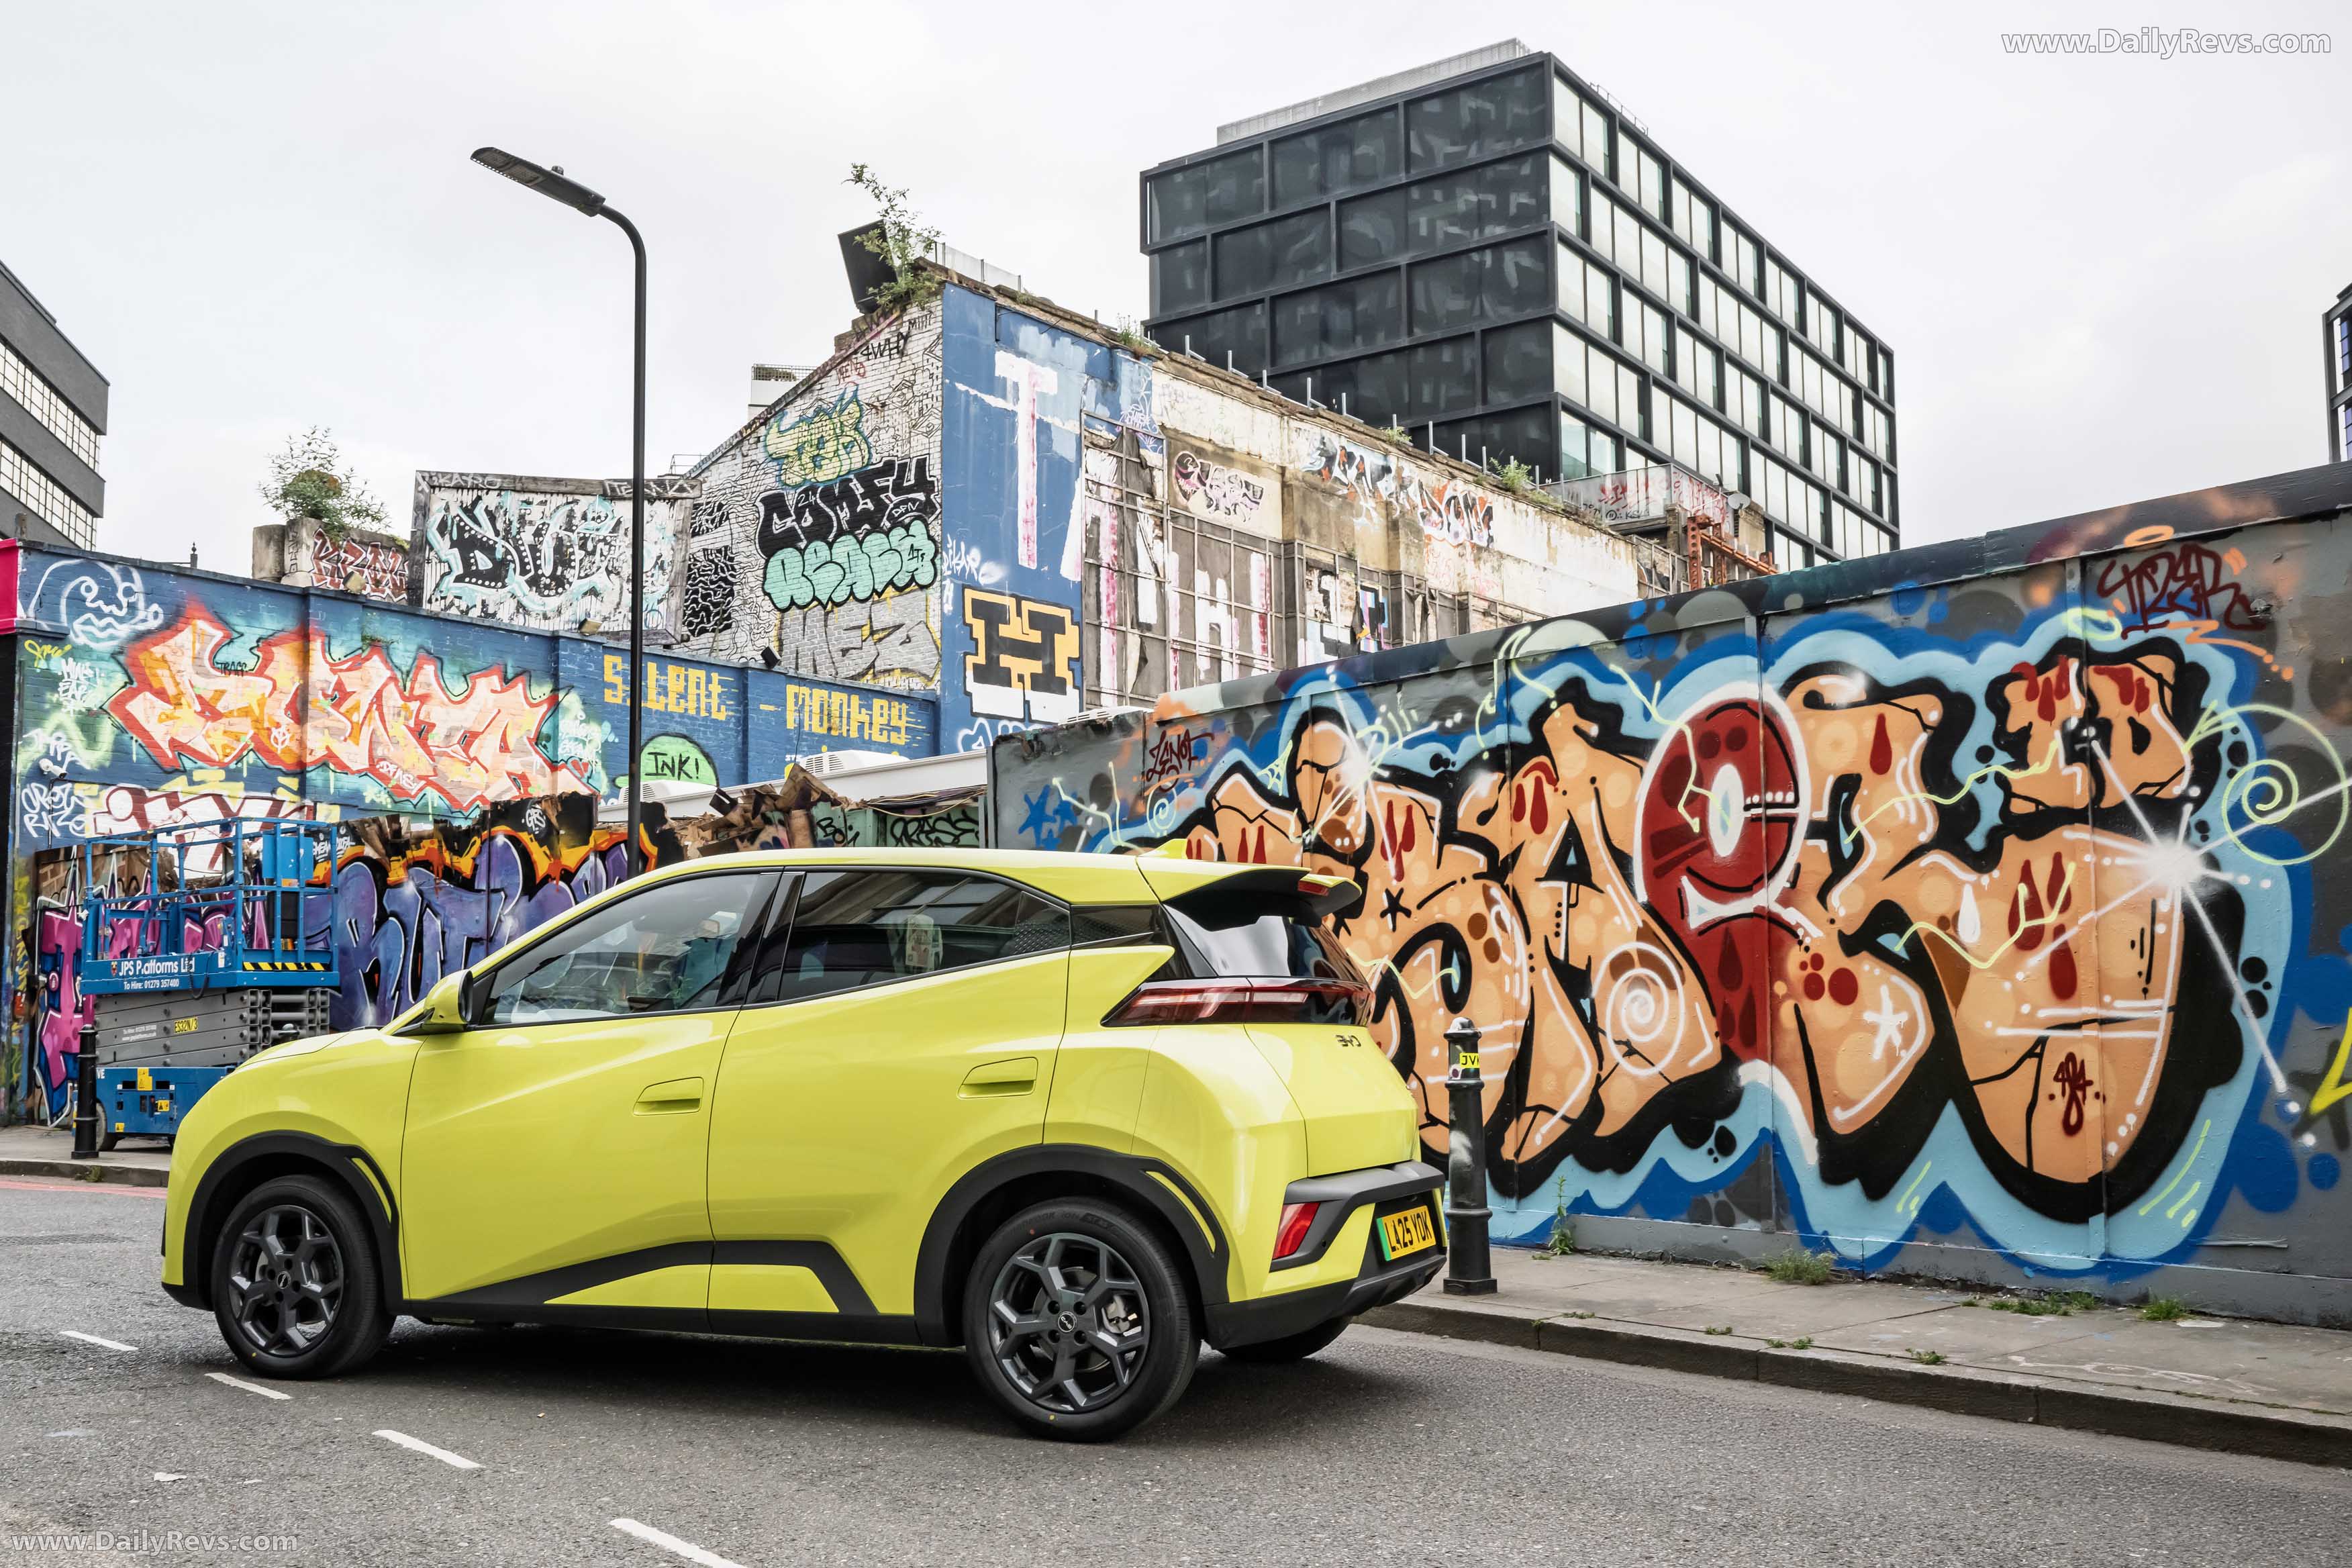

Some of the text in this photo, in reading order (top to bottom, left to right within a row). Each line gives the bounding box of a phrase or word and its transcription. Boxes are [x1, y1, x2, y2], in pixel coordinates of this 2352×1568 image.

[645, 752, 699, 781] INK!
[119, 960, 134, 976] JPS
[124, 981, 130, 990] To
[131, 981, 144, 989] Hire:
[144, 979, 160, 989] 01279
[1385, 1216, 1414, 1253] LA25
